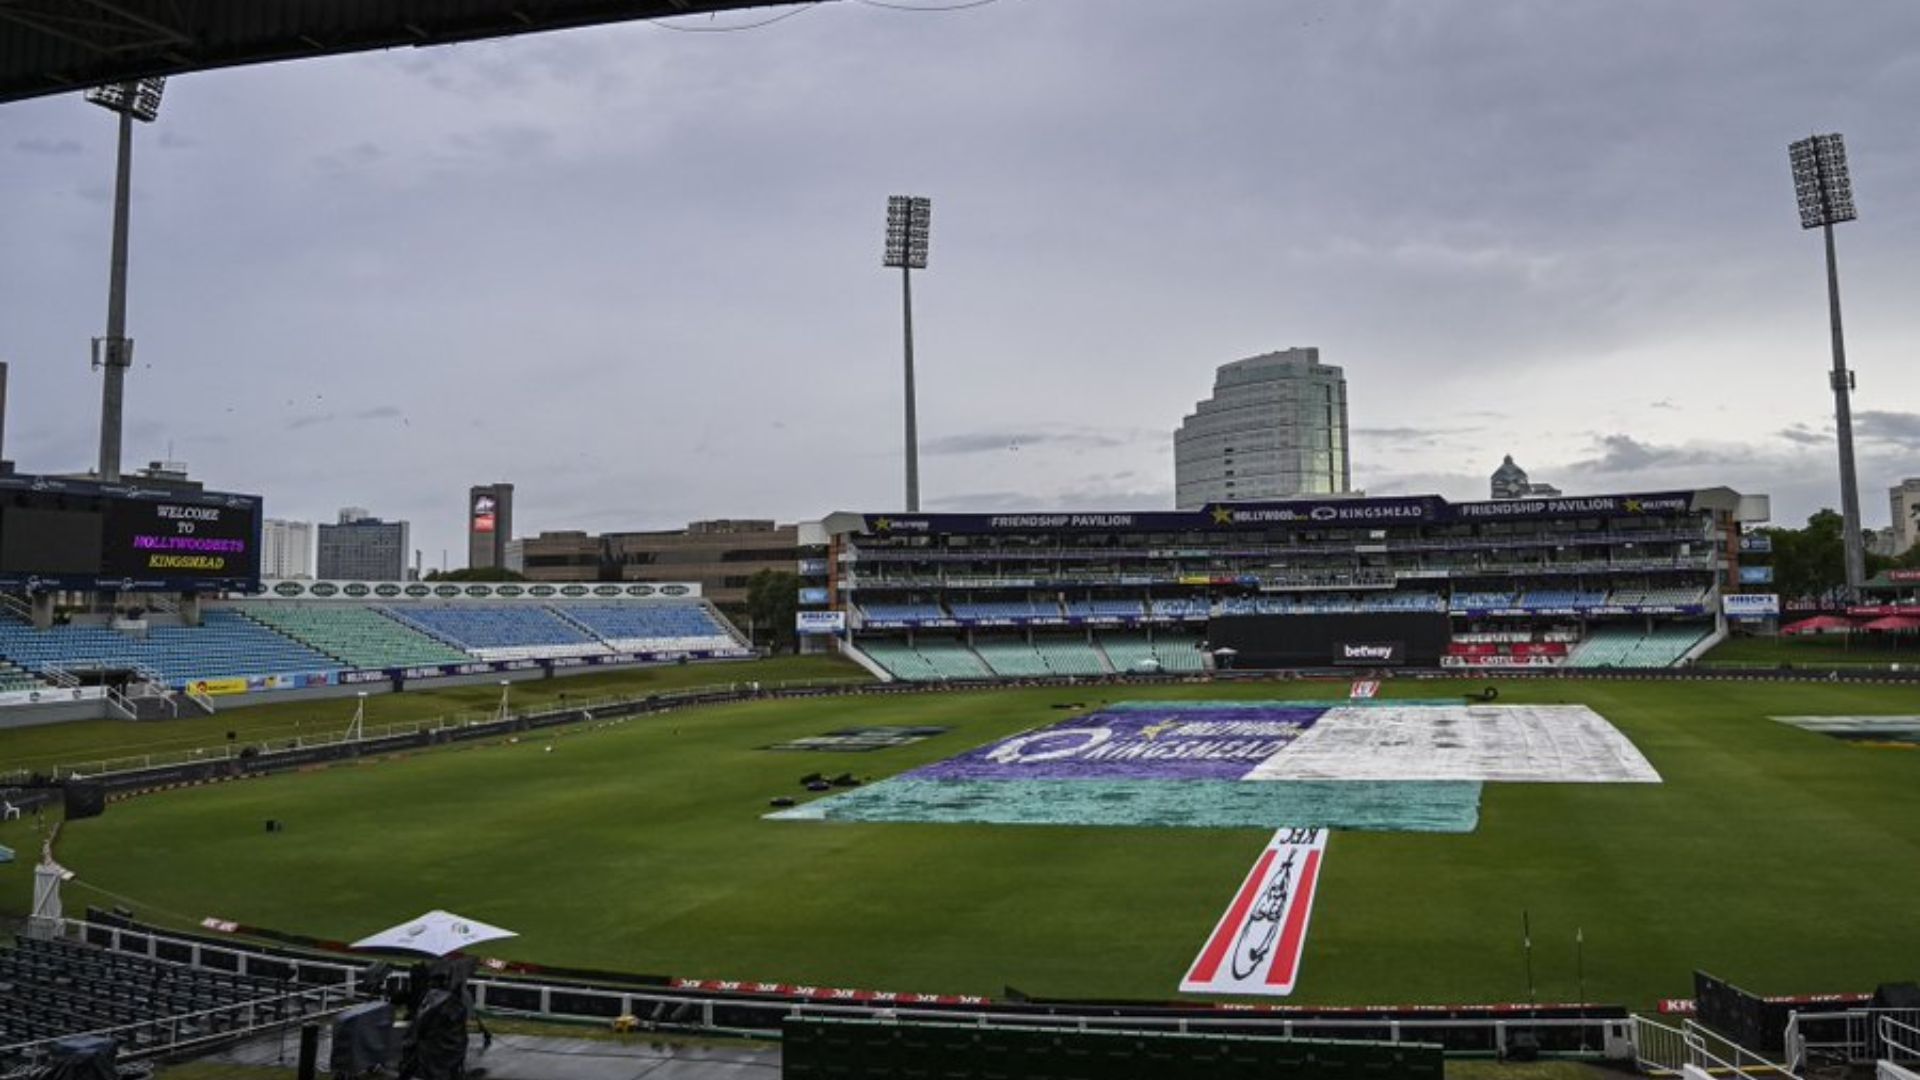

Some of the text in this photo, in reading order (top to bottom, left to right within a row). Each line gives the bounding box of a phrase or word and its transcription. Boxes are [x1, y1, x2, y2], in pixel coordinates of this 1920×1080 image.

[157, 504, 219, 520] WELCOME
[1339, 506, 1422, 519] KINGSMEAD
[1463, 498, 1614, 516] FRIENDSHIP PAVILION
[177, 521, 195, 534] TO
[991, 515, 1132, 528] FRIENDSHIP PAVILION
[149, 554, 225, 570] KINGSMEAD
[1344, 645, 1392, 659] betway
[1280, 828, 1320, 844] KFC
